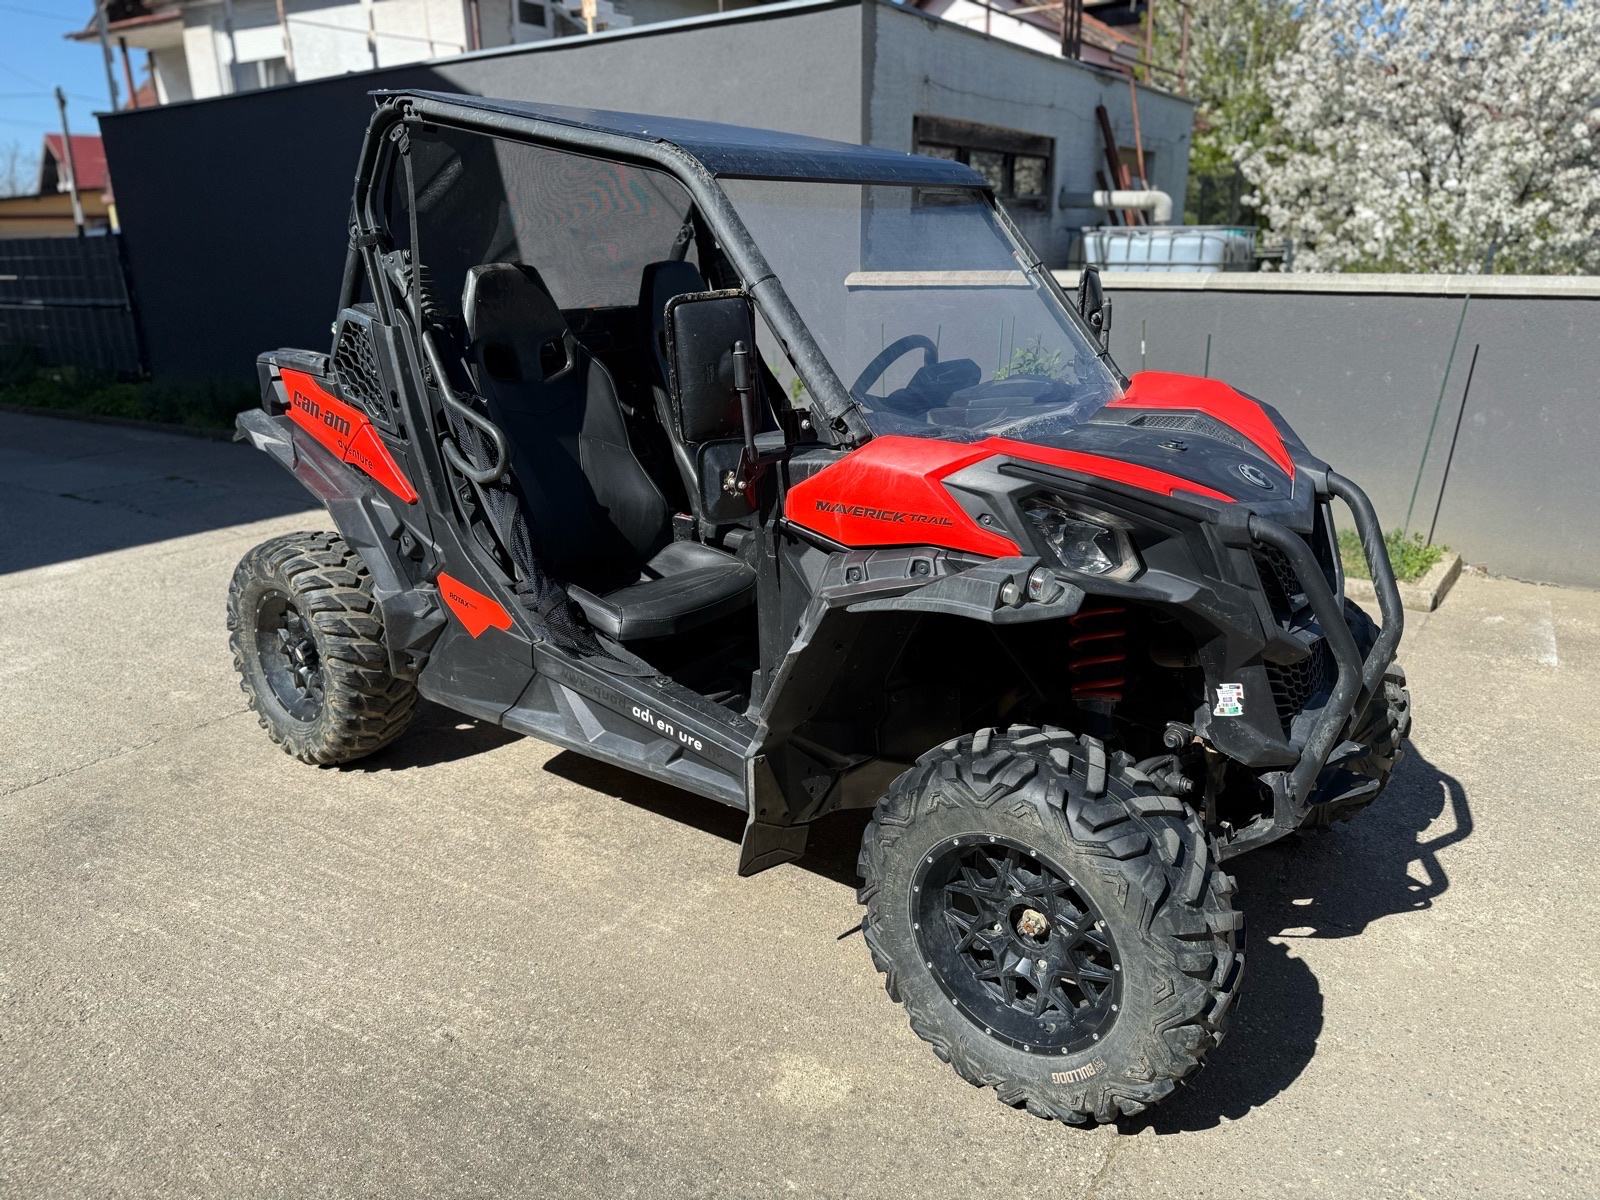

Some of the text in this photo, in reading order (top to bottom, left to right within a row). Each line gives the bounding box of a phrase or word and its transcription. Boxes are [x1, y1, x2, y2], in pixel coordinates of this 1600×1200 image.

[815, 500, 953, 526] MAVERICK TRAIL
[449, 592, 469, 608] ROTAX
[1051, 1062, 1096, 1084] BULLDOG
